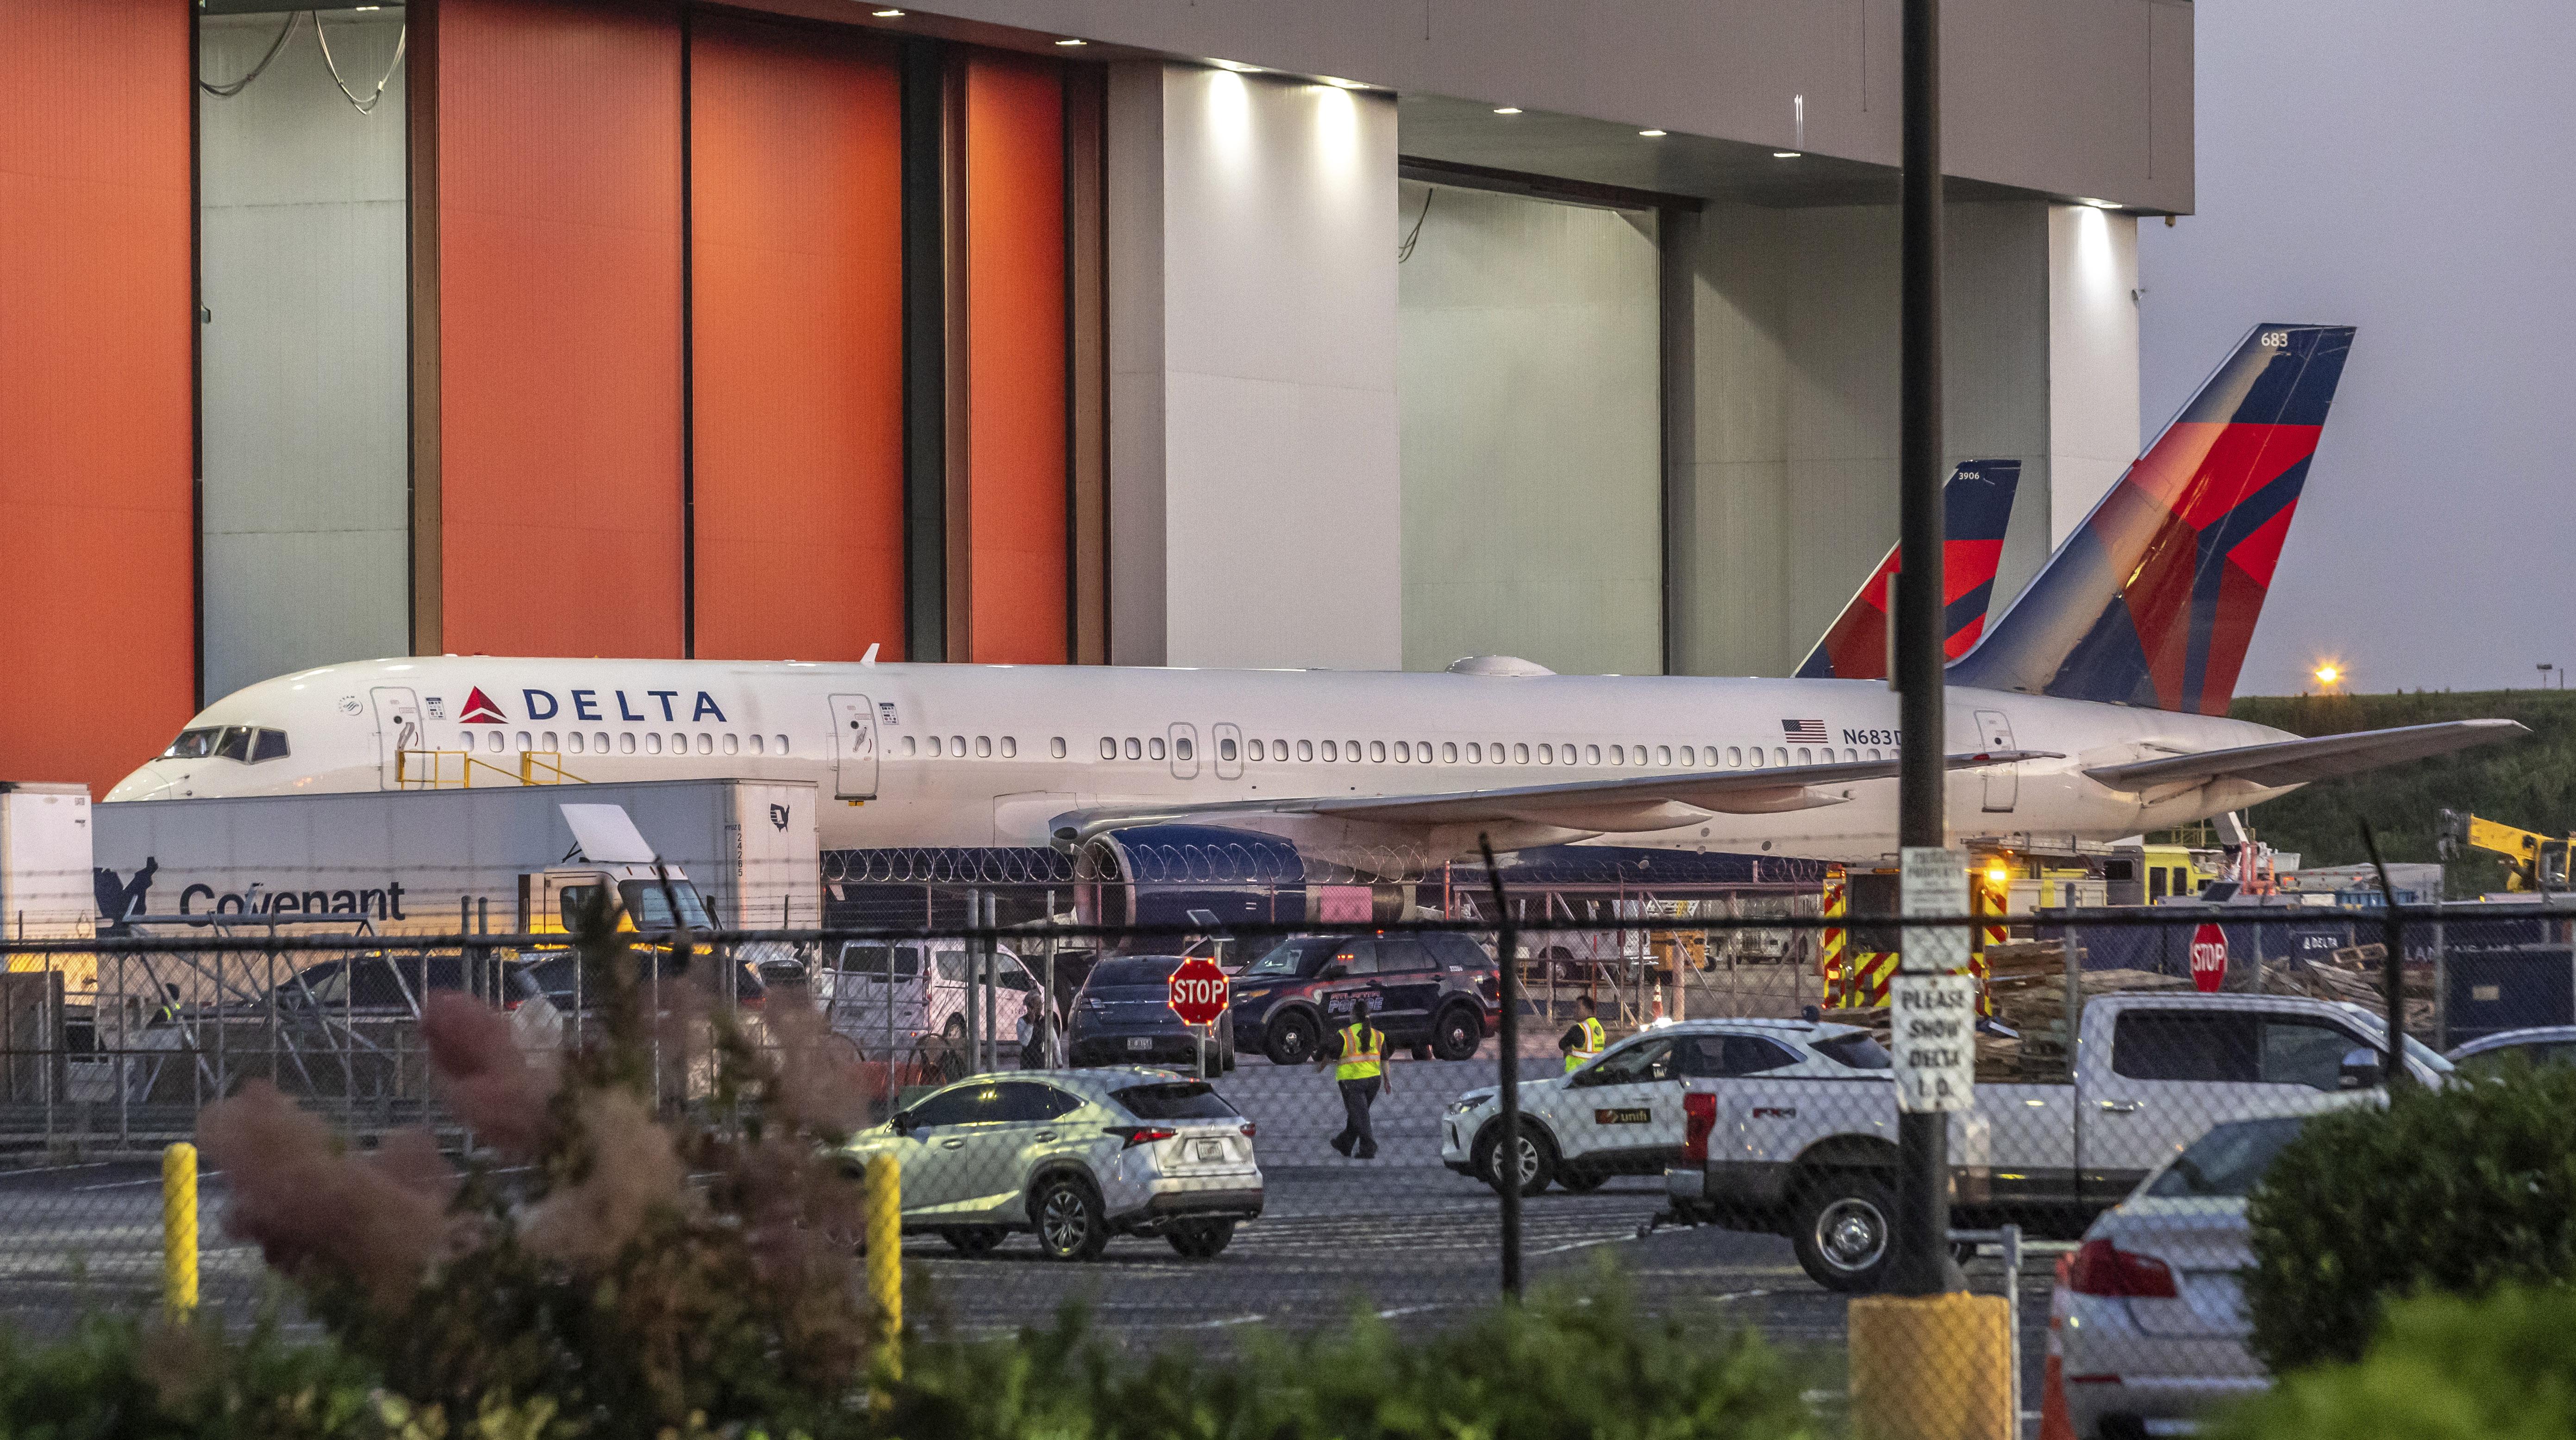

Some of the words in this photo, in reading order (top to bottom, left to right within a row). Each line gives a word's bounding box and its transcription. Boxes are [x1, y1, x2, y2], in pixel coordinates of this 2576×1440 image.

[2261, 332, 2288, 347] 683
[1959, 472, 1980, 480] 3906
[523, 689, 727, 722] DELTA
[180, 882, 406, 927] Covenant
[2194, 943, 2224, 971] STOP
[1174, 979, 1224, 1004] STOP
[1901, 990, 1964, 1010] PLEASE
[1328, 997, 1383, 1013] POLCE
[1909, 1019, 1960, 1038] SHOW
[1909, 1050, 1959, 1067] DELTA
